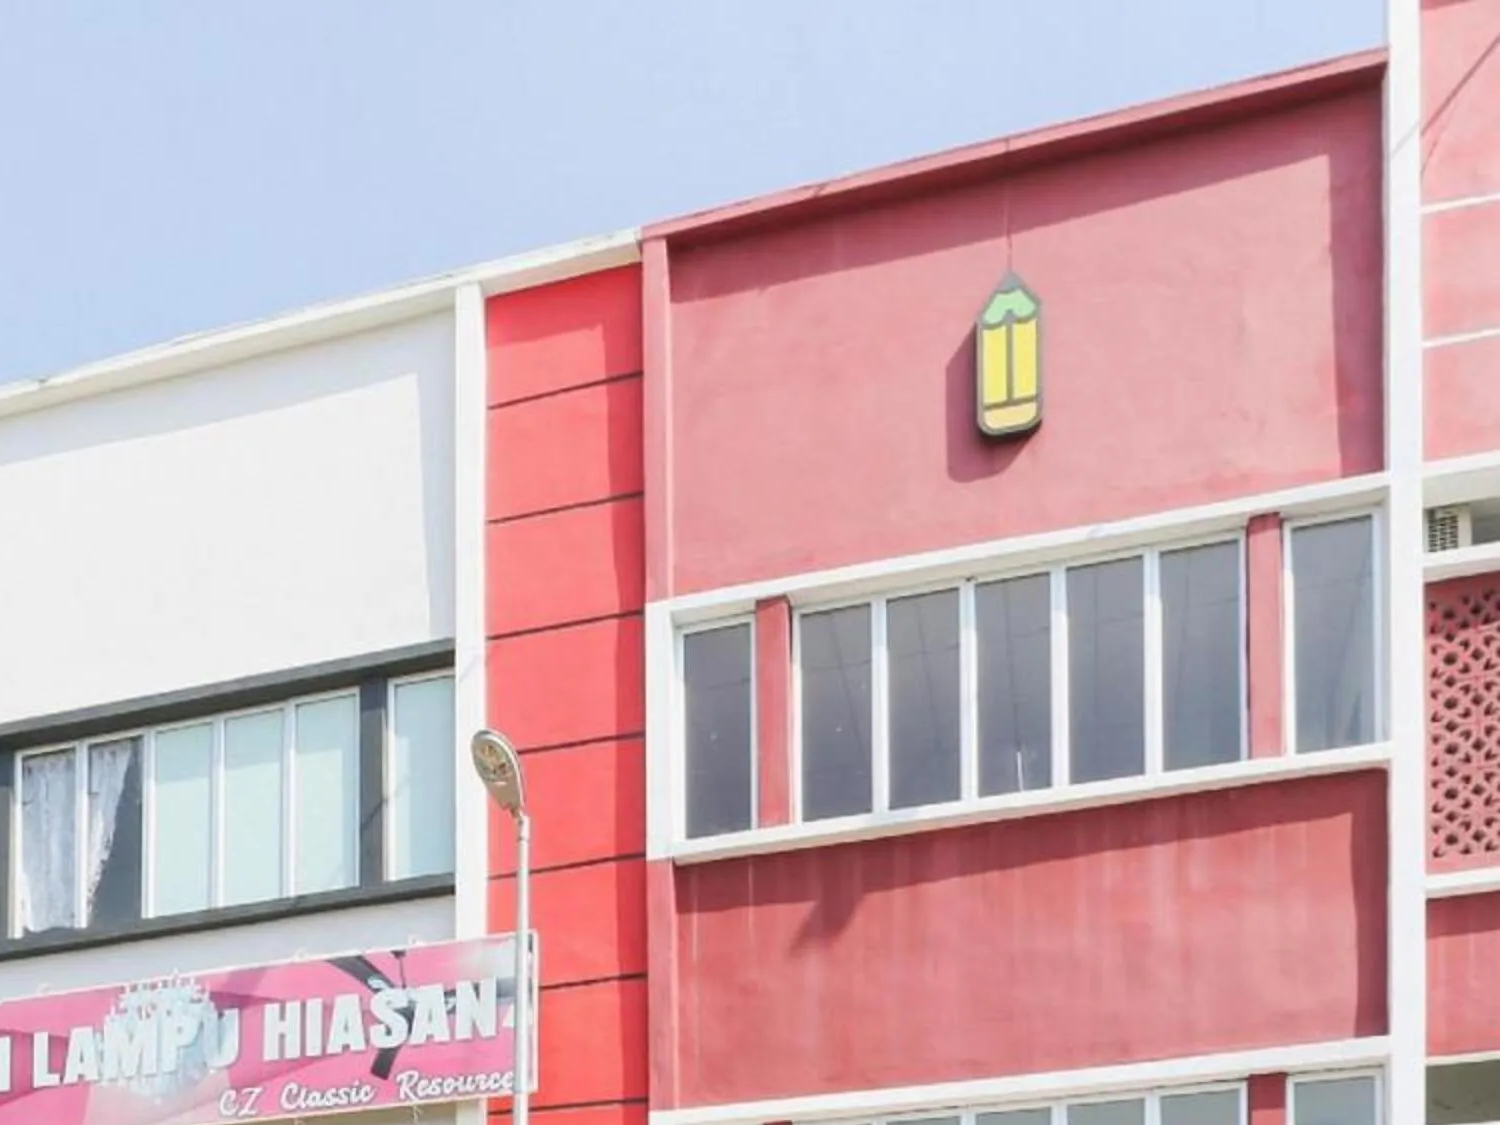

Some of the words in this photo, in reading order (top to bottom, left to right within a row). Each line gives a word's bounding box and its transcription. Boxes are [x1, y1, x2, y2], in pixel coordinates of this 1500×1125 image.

[32, 1008, 241, 1089] LAMPU
[262, 976, 498, 1063] HIASAN
[219, 1086, 264, 1117] CZ
[280, 1079, 376, 1111] Classic
